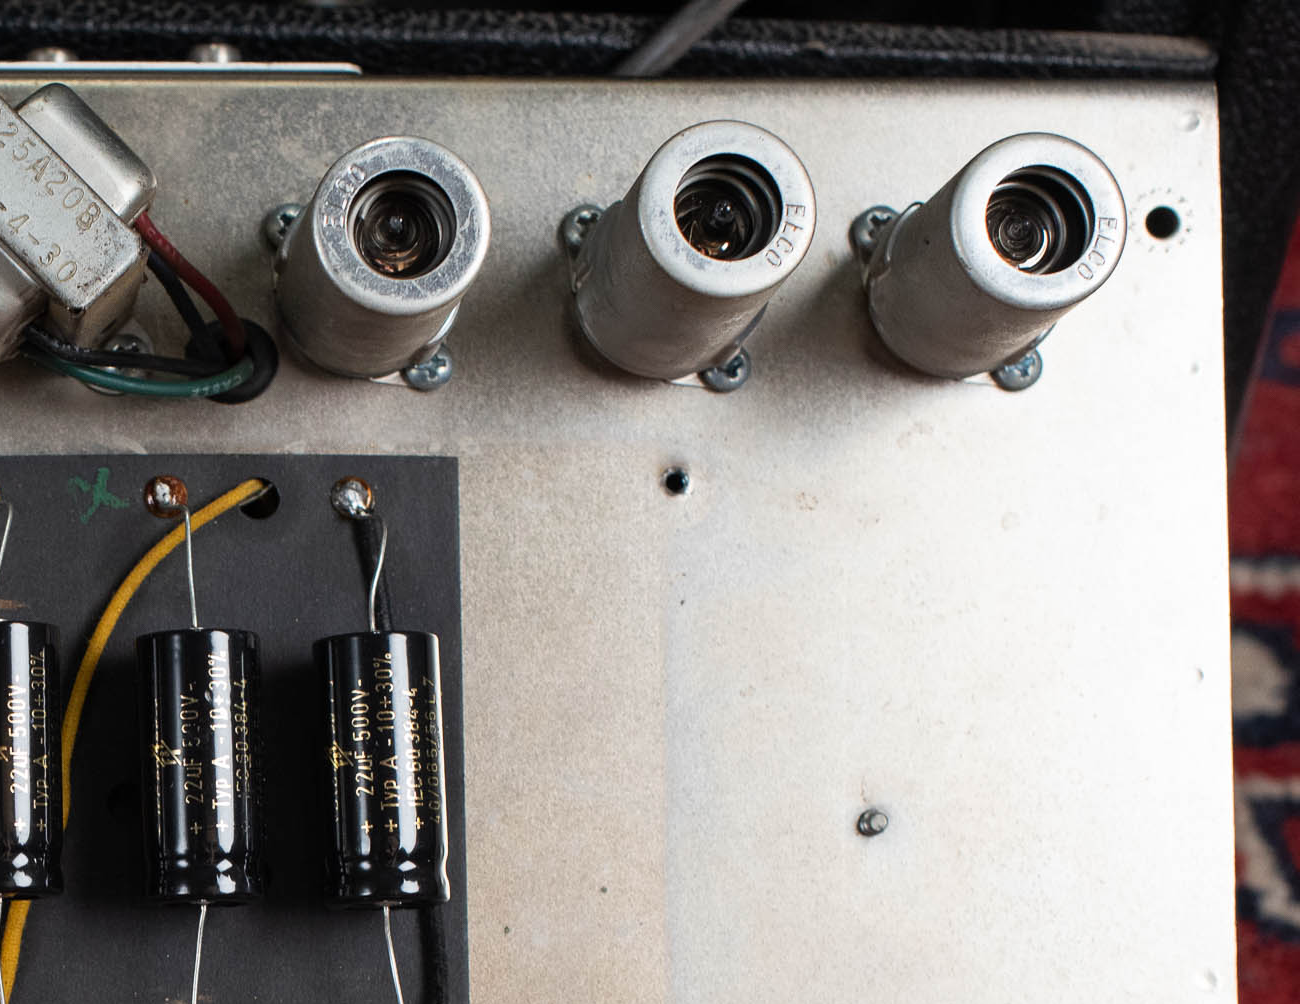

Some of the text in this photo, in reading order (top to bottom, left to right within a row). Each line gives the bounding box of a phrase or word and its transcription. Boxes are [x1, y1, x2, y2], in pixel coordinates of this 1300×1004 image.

[765, 203, 806, 268] ELCO
[1077, 216, 1117, 281] ELCO
[33, 755, 48, 768] A
[212, 754, 230, 768] A
[380, 755, 399, 769] A
[405, 749, 421, 772] 60
[33, 779, 49, 809] Typ
[212, 778, 231, 809] Typ
[380, 779, 400, 810] Typ
[406, 776, 424, 807] IEC
